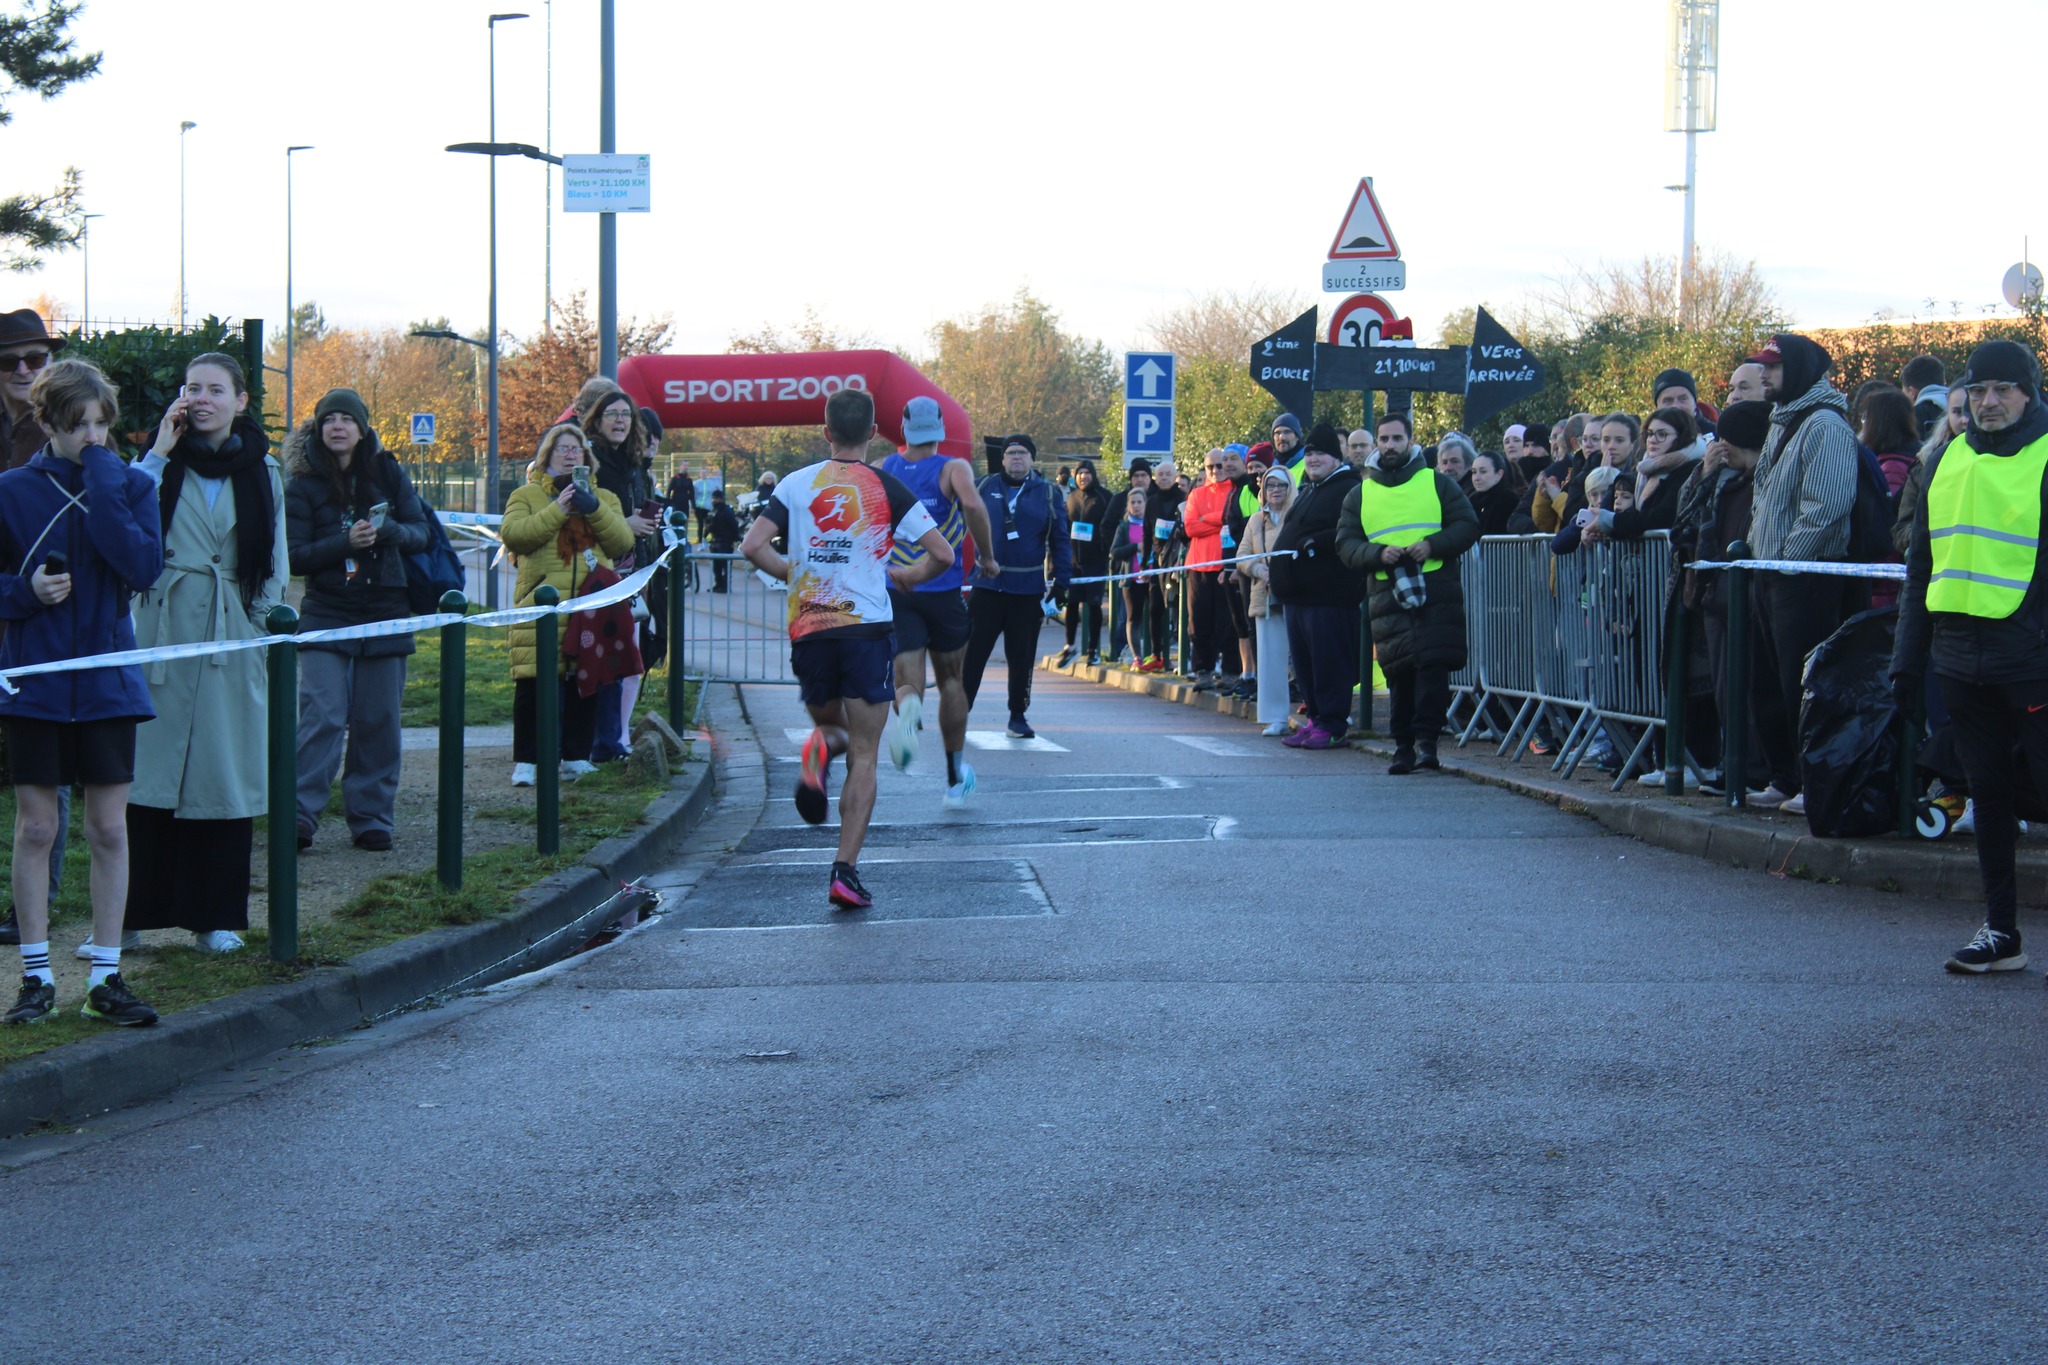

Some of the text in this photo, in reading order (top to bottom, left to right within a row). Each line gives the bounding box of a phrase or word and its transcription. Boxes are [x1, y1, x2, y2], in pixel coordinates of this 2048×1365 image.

[567, 179, 590, 187] Verts
[600, 179, 630, 187] 21.100
[632, 179, 646, 187] KM
[567, 190, 591, 198] Bleus
[601, 190, 612, 198] 10
[614, 190, 628, 198] KM
[1360, 265, 1366, 275] 2
[1326, 276, 1401, 289] SUCCESSIFS
[1343, 319, 1383, 348] 30
[1480, 344, 1523, 360] VERS
[1261, 366, 1311, 381] BOUCLE
[1468, 364, 1536, 383] ARRIVÉE
[1137, 413, 1160, 444] P
[809, 535, 853, 549] Corrida
[807, 550, 850, 564] Houilles
